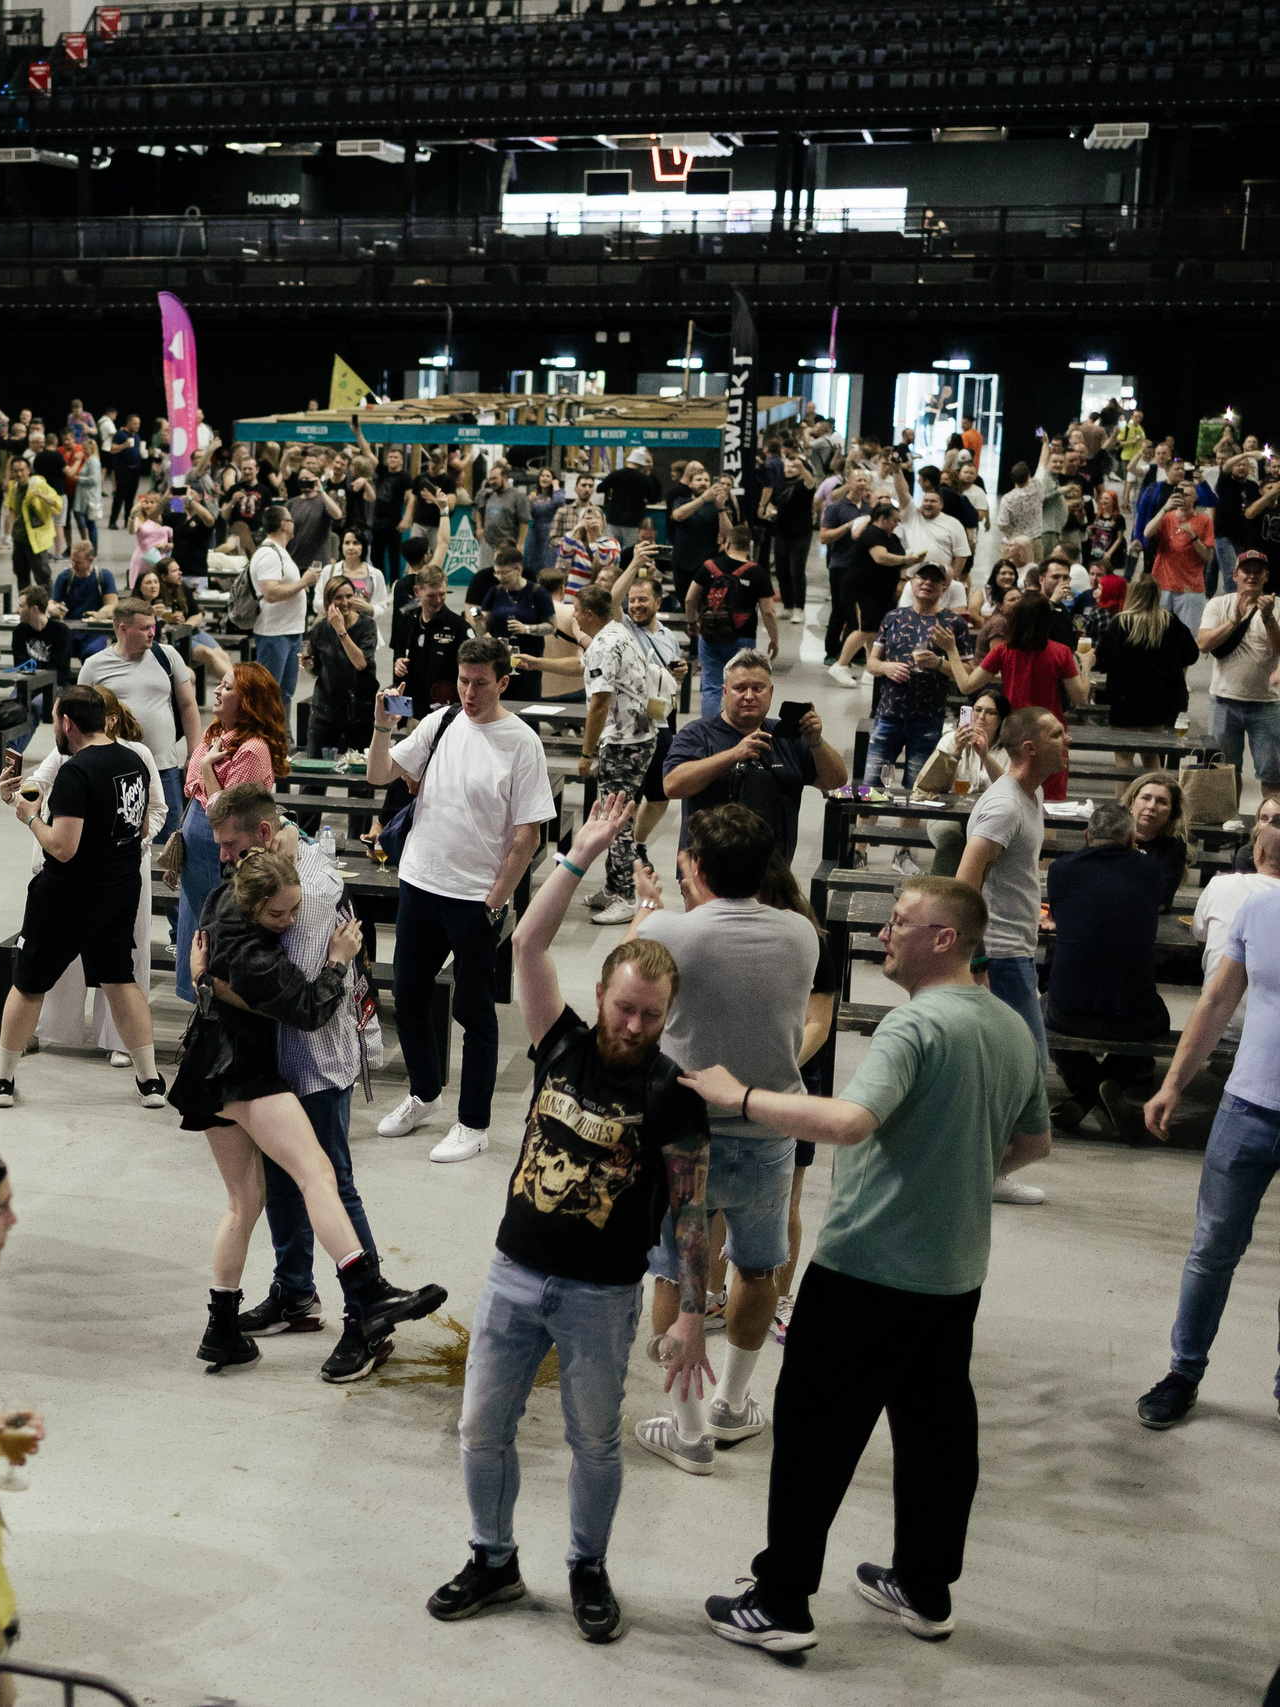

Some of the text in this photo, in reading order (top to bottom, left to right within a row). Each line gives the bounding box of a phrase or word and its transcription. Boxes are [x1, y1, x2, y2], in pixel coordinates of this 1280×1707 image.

[247, 191, 300, 208] lounge
[744, 401, 753, 448] BREWERY
[447, 556, 479, 572] BEER
[573, 1115, 615, 1144] ROSES
